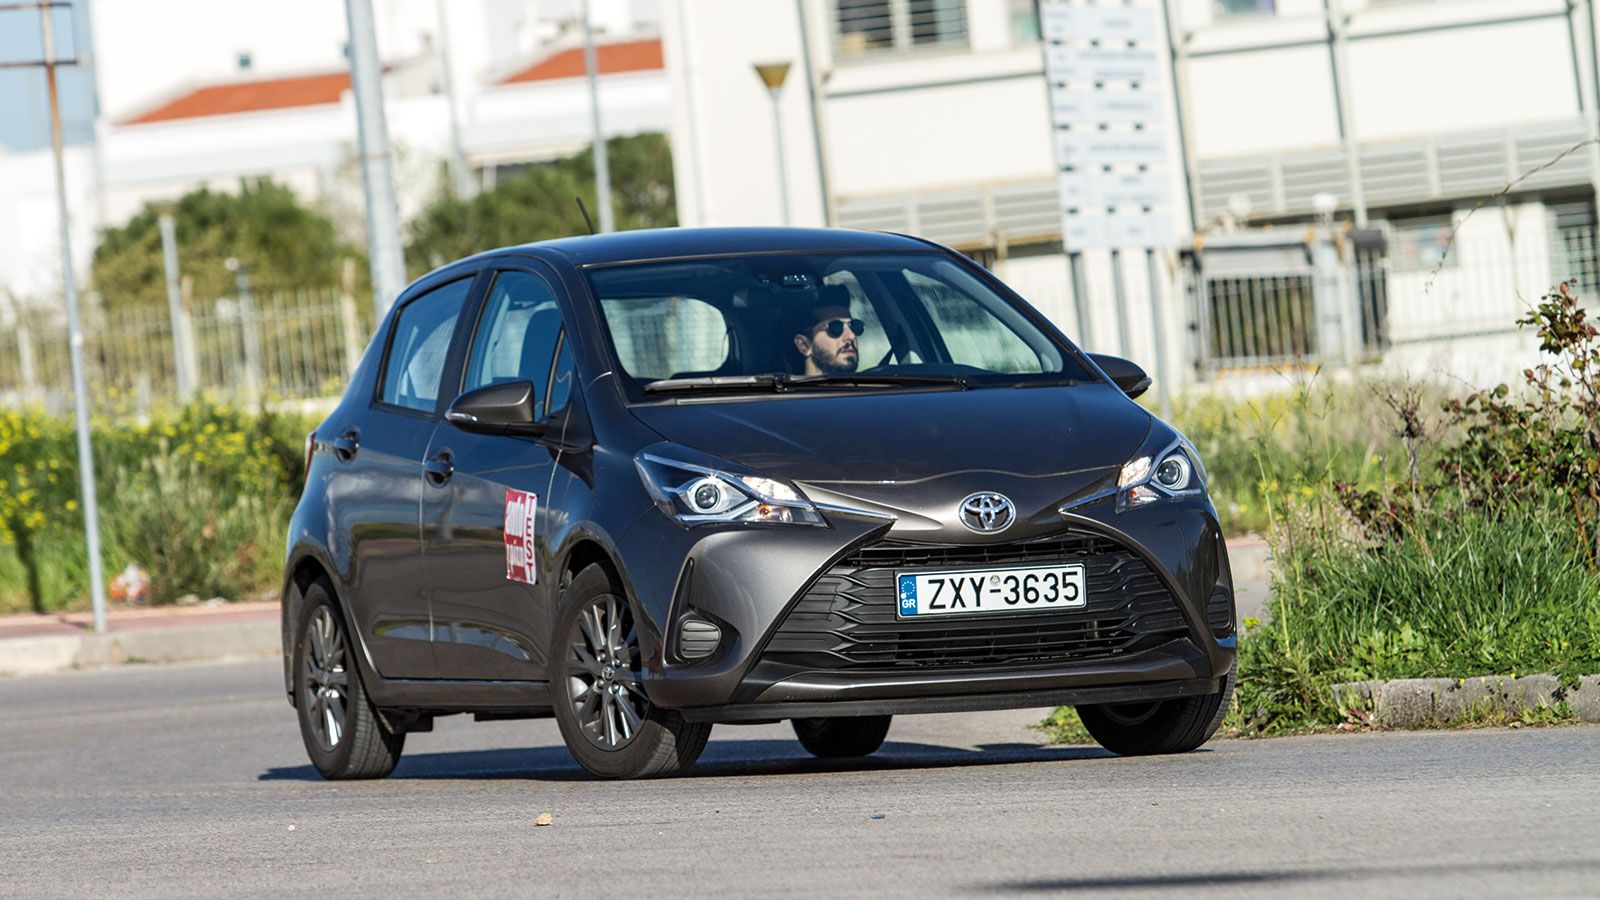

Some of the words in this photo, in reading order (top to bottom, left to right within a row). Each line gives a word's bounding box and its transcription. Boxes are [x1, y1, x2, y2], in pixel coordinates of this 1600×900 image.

[526, 495, 535, 582] TEST
[902, 599, 916, 609] GR
[928, 571, 1080, 610] ZXY-3635
